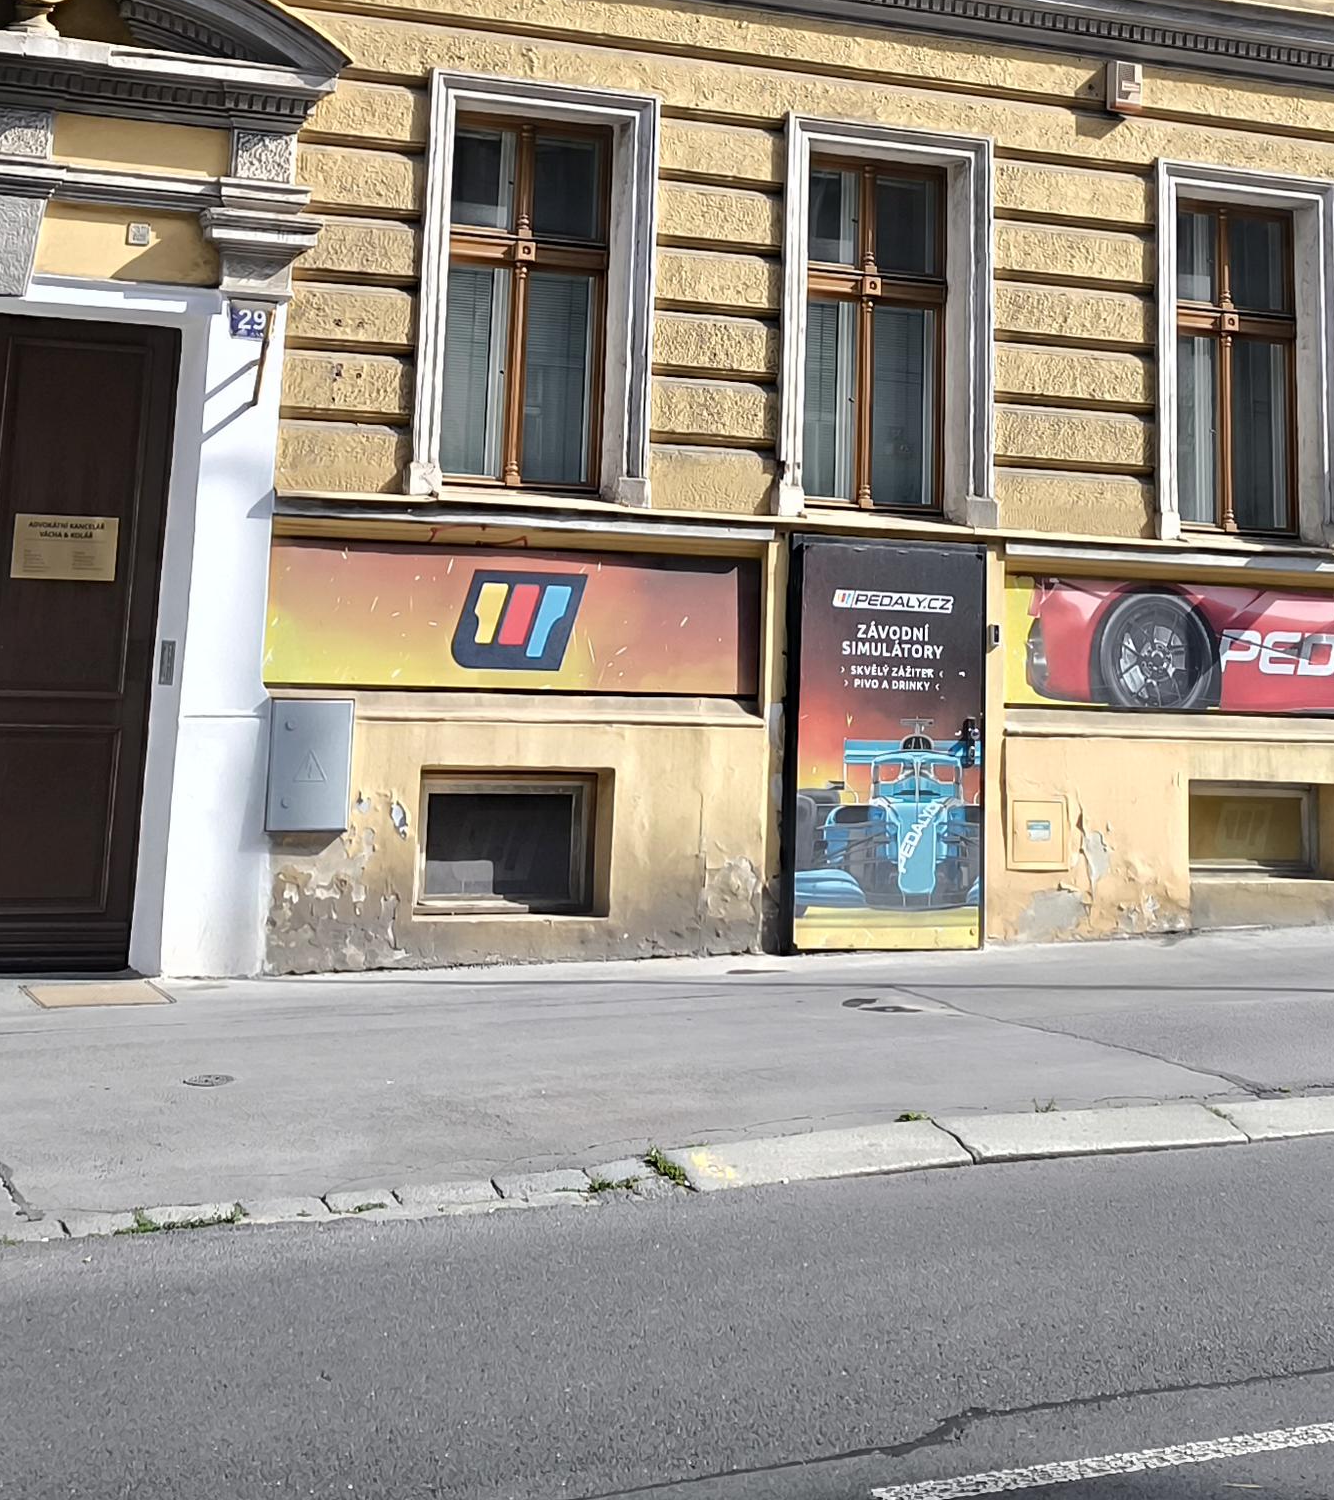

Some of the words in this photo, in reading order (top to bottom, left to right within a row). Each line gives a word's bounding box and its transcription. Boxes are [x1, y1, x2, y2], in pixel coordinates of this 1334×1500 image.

[238, 309, 267, 330] 29
[854, 593, 952, 611] PEDALY.CZ
[856, 620, 929, 642] ZÁVODNÍ
[841, 639, 944, 660] SIMULÁTORY
[850, 664, 889, 676] SKVĚLÝ
[891, 665, 935, 678] ZÁŽITEK
[853, 679, 879, 688] PIVO
[881, 680, 889, 689] A
[891, 680, 931, 691] DRINKY
